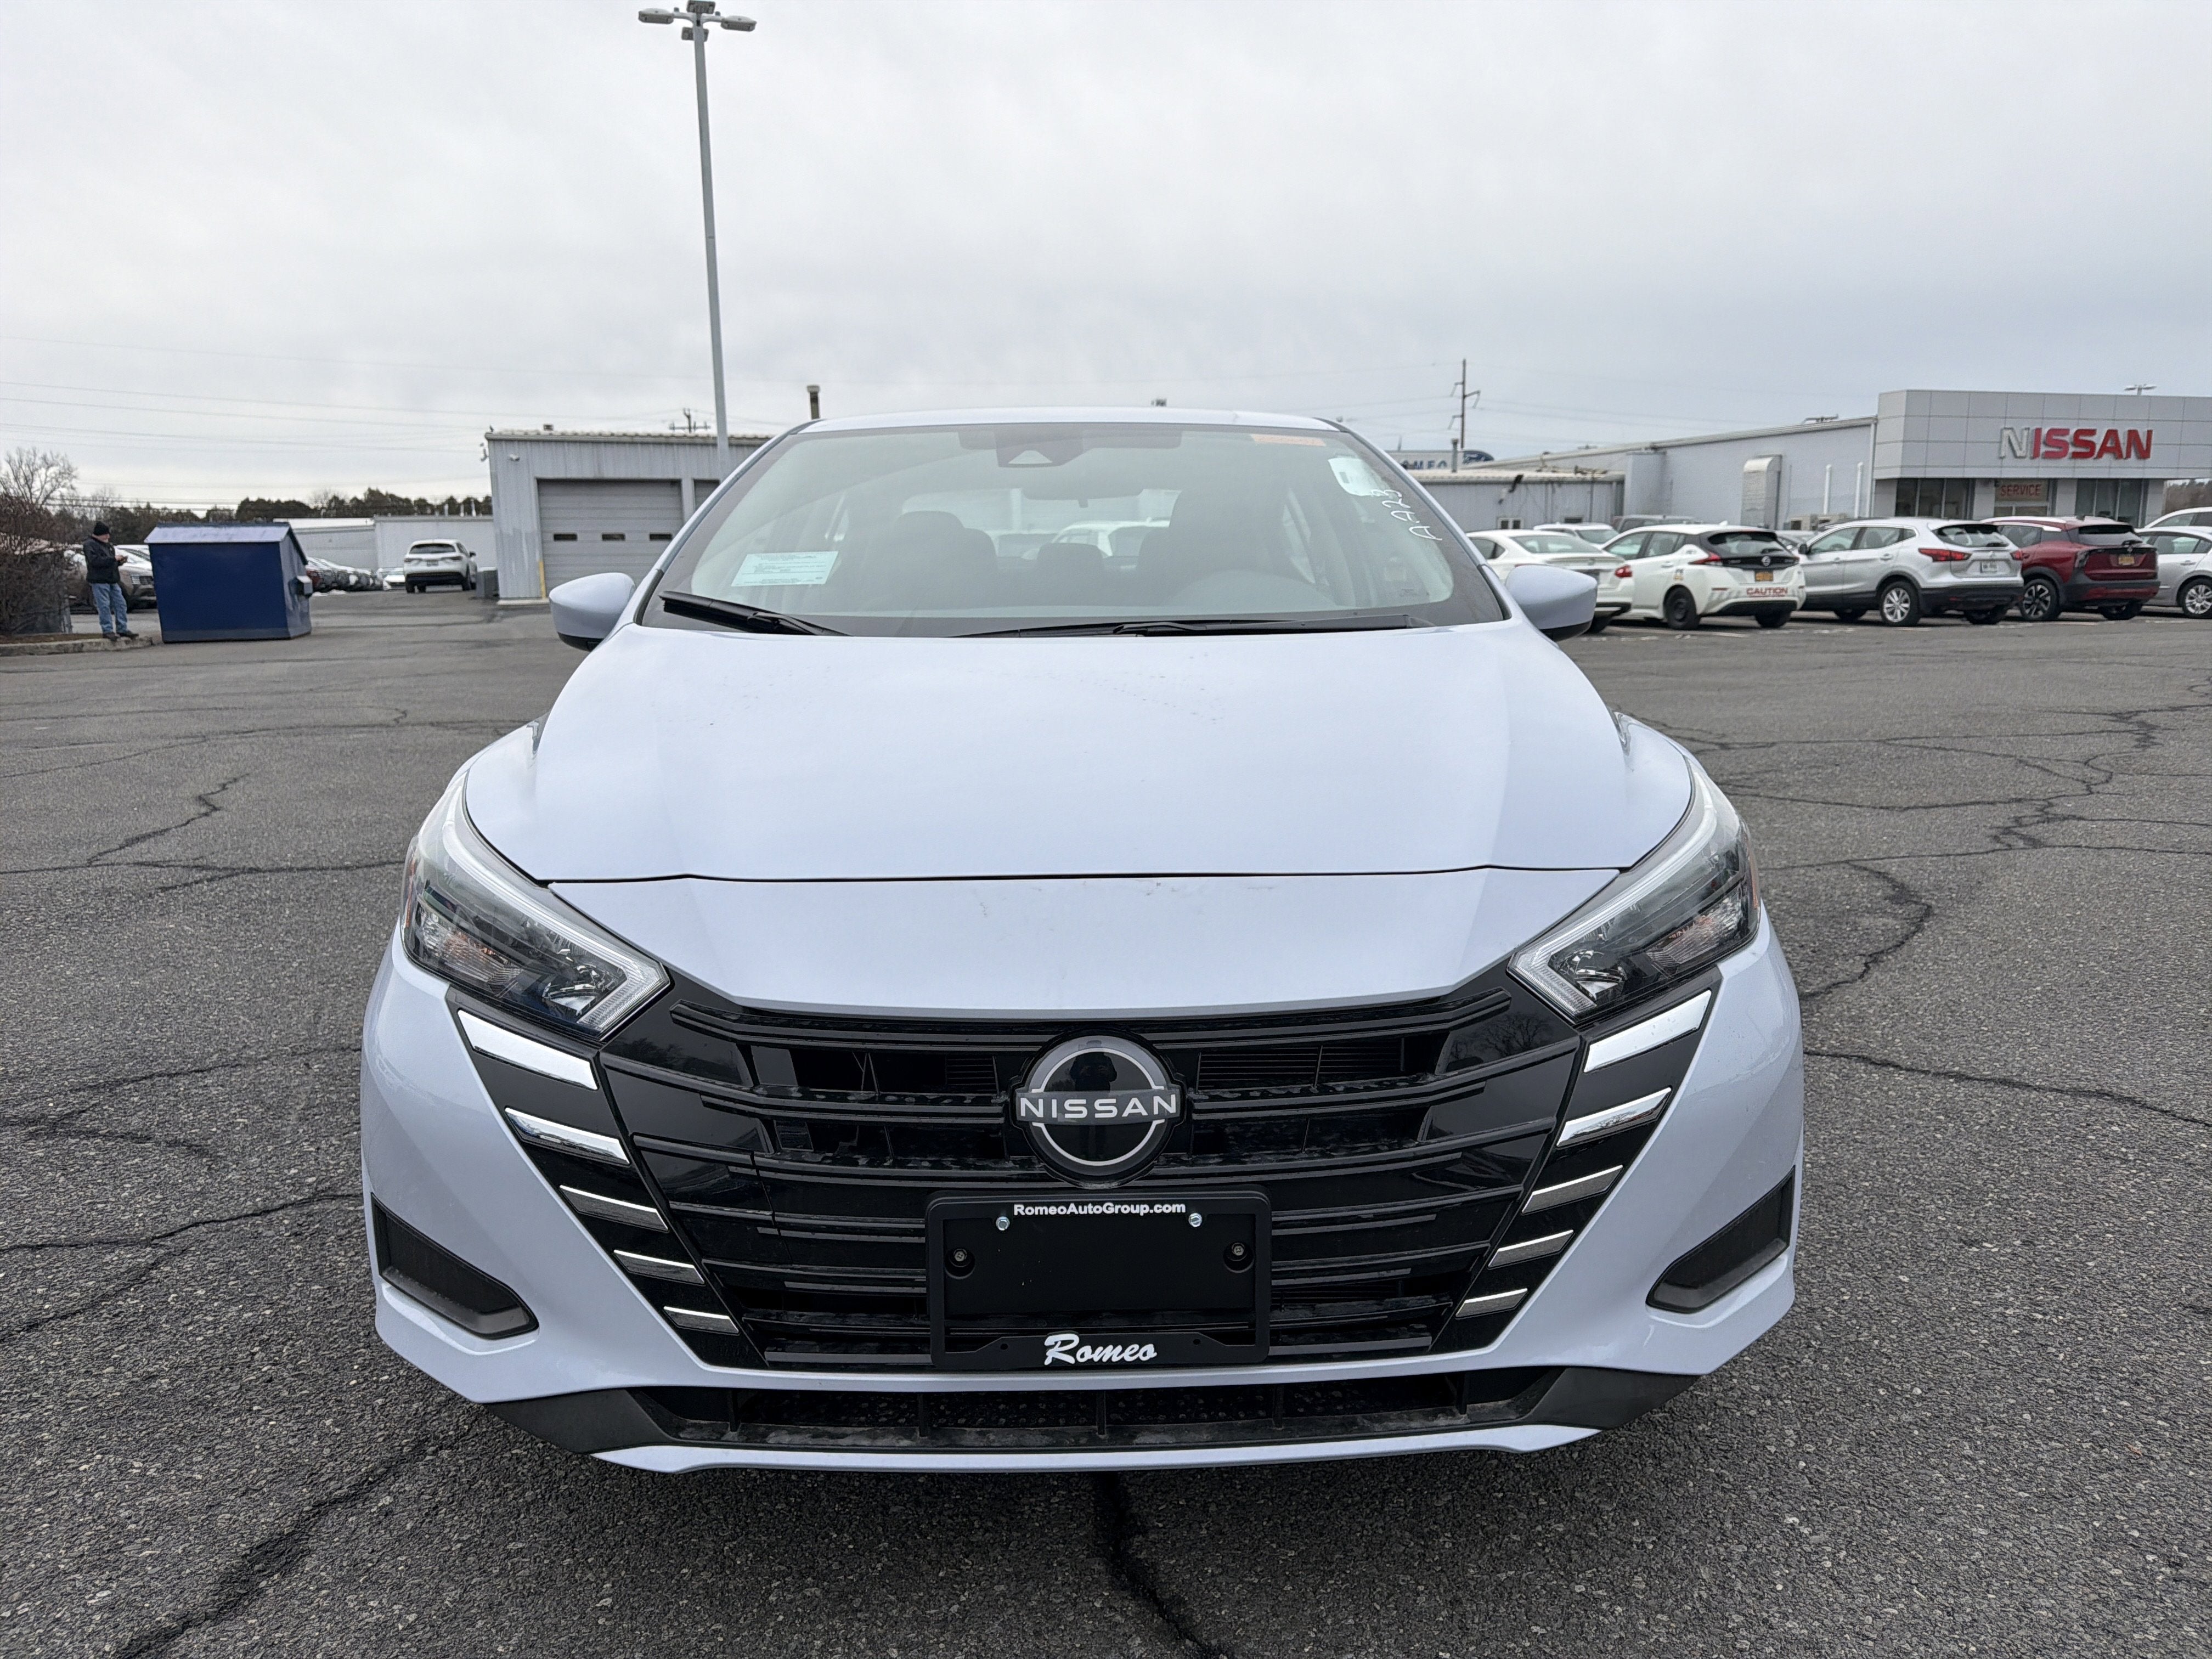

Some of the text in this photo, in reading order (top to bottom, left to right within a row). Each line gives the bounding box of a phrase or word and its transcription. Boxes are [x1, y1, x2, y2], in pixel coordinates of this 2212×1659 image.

[2000, 427, 2153, 460] NISSAN
[2000, 484, 2041, 496] SERVICE
[1746, 586, 1788, 596] CAUTION
[1019, 1094, 1177, 1119] NISSAN
[1013, 1202, 1186, 1216] RomeoAutoGroup.com
[1043, 1333, 1157, 1366] Romeo
